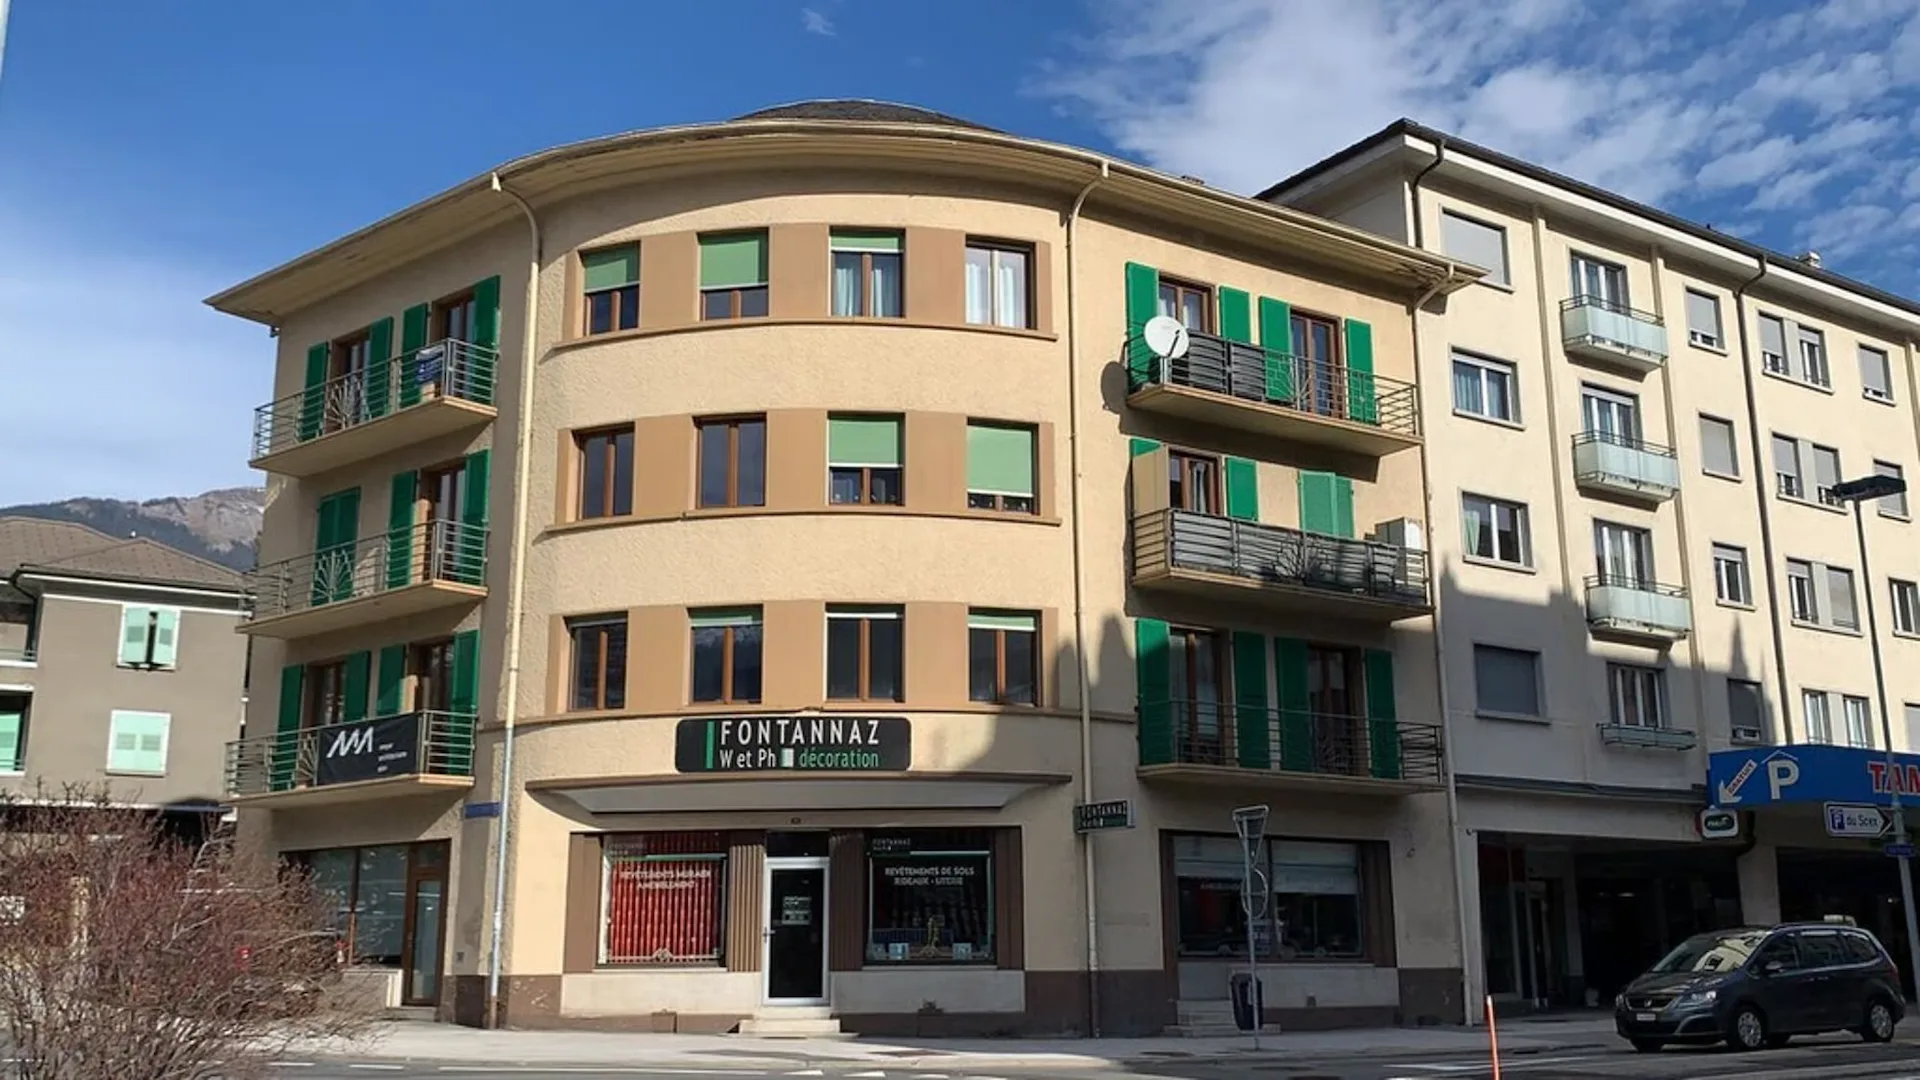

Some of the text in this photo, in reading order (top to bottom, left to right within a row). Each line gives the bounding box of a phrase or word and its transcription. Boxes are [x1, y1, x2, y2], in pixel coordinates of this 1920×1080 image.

[720, 719, 880, 745] FONTANNAZ
[720, 747, 879, 768] W et Ph décoration
[1768, 759, 1799, 800] P
